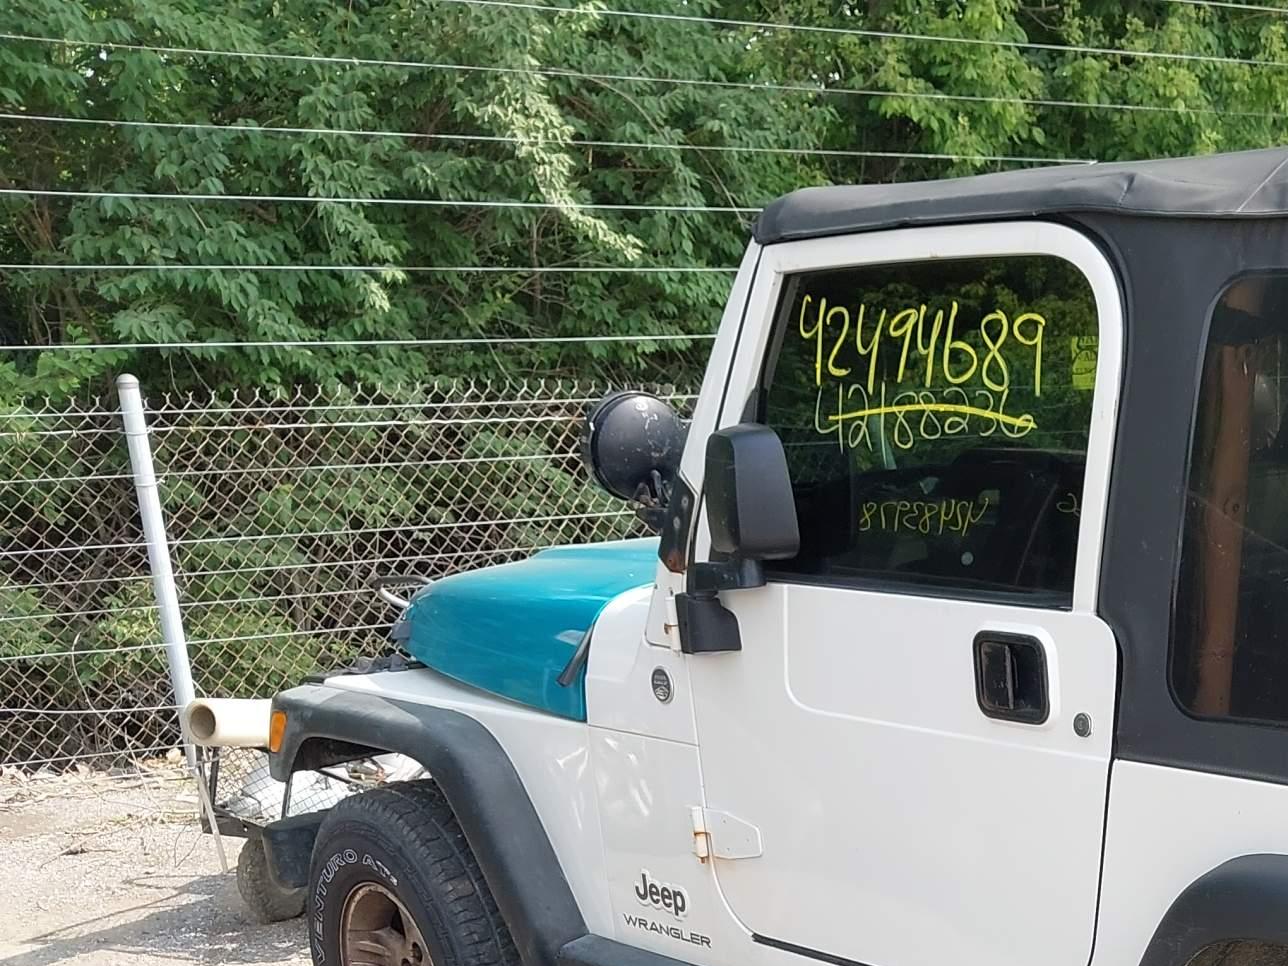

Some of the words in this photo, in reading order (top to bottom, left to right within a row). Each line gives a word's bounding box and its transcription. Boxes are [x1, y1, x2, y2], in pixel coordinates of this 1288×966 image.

[799, 293, 1046, 397] 42494689
[634, 872, 686, 917] Jeep
[622, 912, 713, 949] WRANGLER
